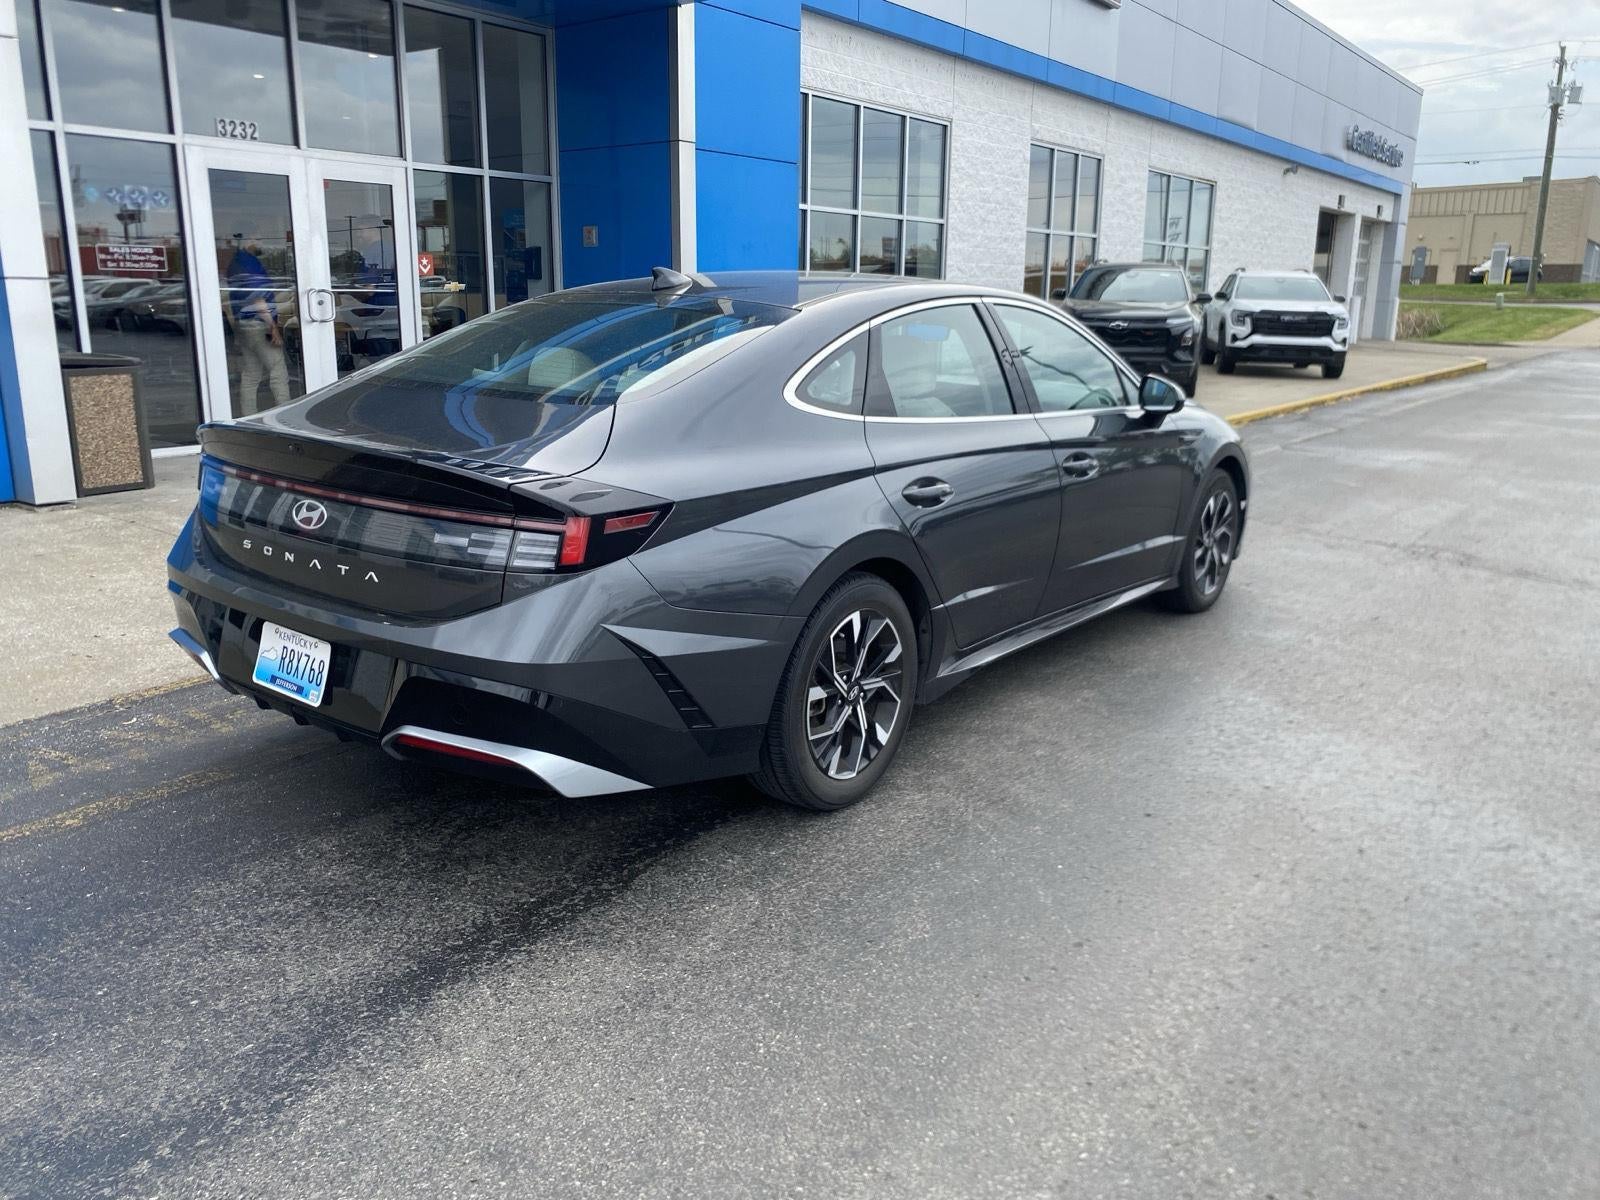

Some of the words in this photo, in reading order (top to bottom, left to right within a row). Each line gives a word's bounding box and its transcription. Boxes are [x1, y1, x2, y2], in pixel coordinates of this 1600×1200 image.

[218, 118, 257, 140] 3232
[242, 539, 379, 583] SONATA
[278, 631, 314, 650] KENTUCKY
[277, 645, 325, 687] R8X768
[275, 678, 298, 691] JEFFERSON
